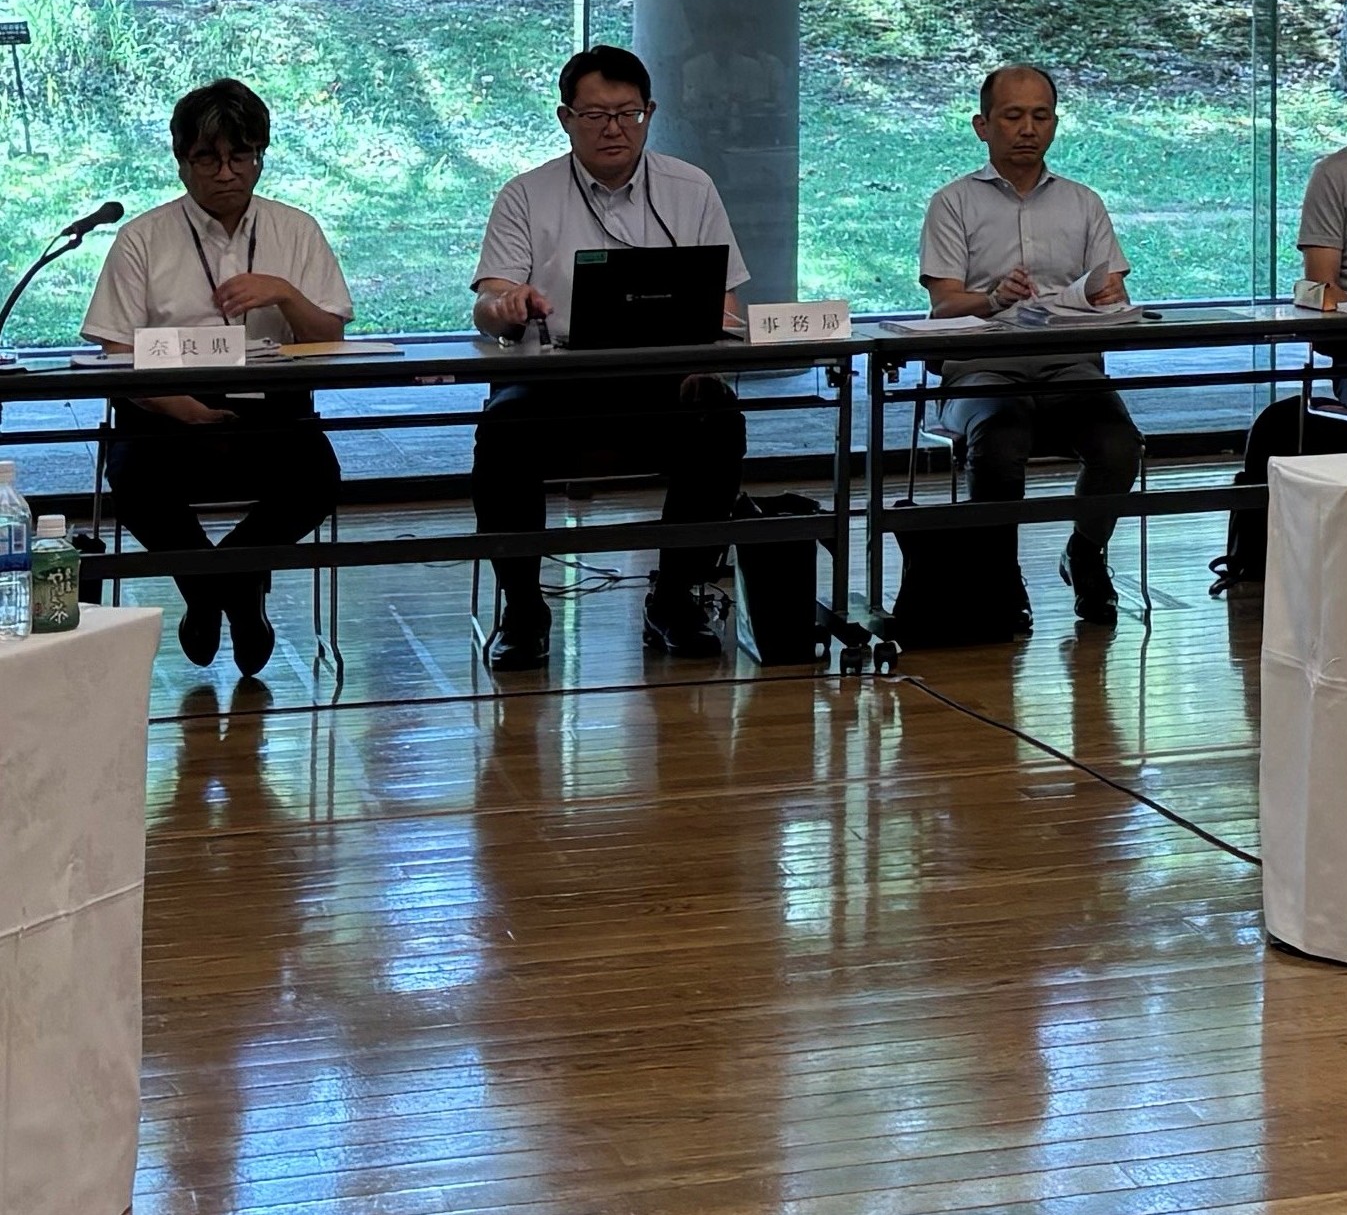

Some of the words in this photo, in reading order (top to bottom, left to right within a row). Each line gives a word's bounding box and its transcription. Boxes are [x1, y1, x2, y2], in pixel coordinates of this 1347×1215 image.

[759, 312, 840, 334] 事務局
[148, 337, 230, 356] 奈良県
